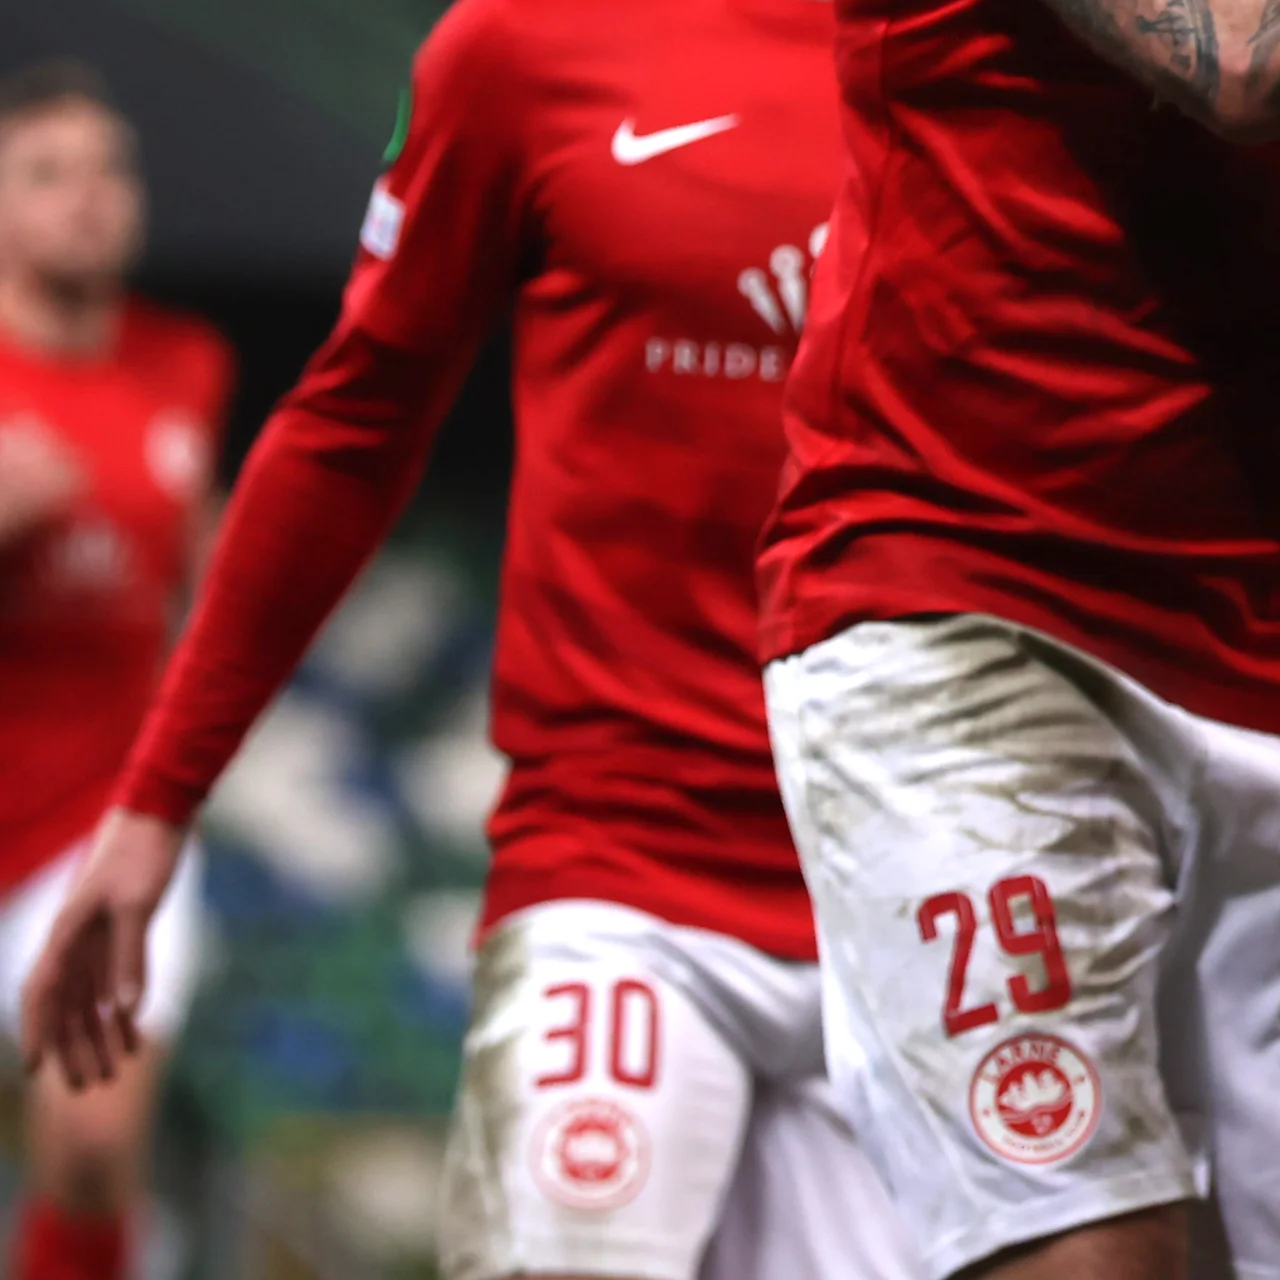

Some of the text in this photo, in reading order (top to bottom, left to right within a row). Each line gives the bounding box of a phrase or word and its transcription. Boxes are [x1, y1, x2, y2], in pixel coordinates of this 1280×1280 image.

[644, 336, 786, 383] PRIDE
[915, 873, 1074, 1038] 29
[533, 977, 661, 1092] 30
